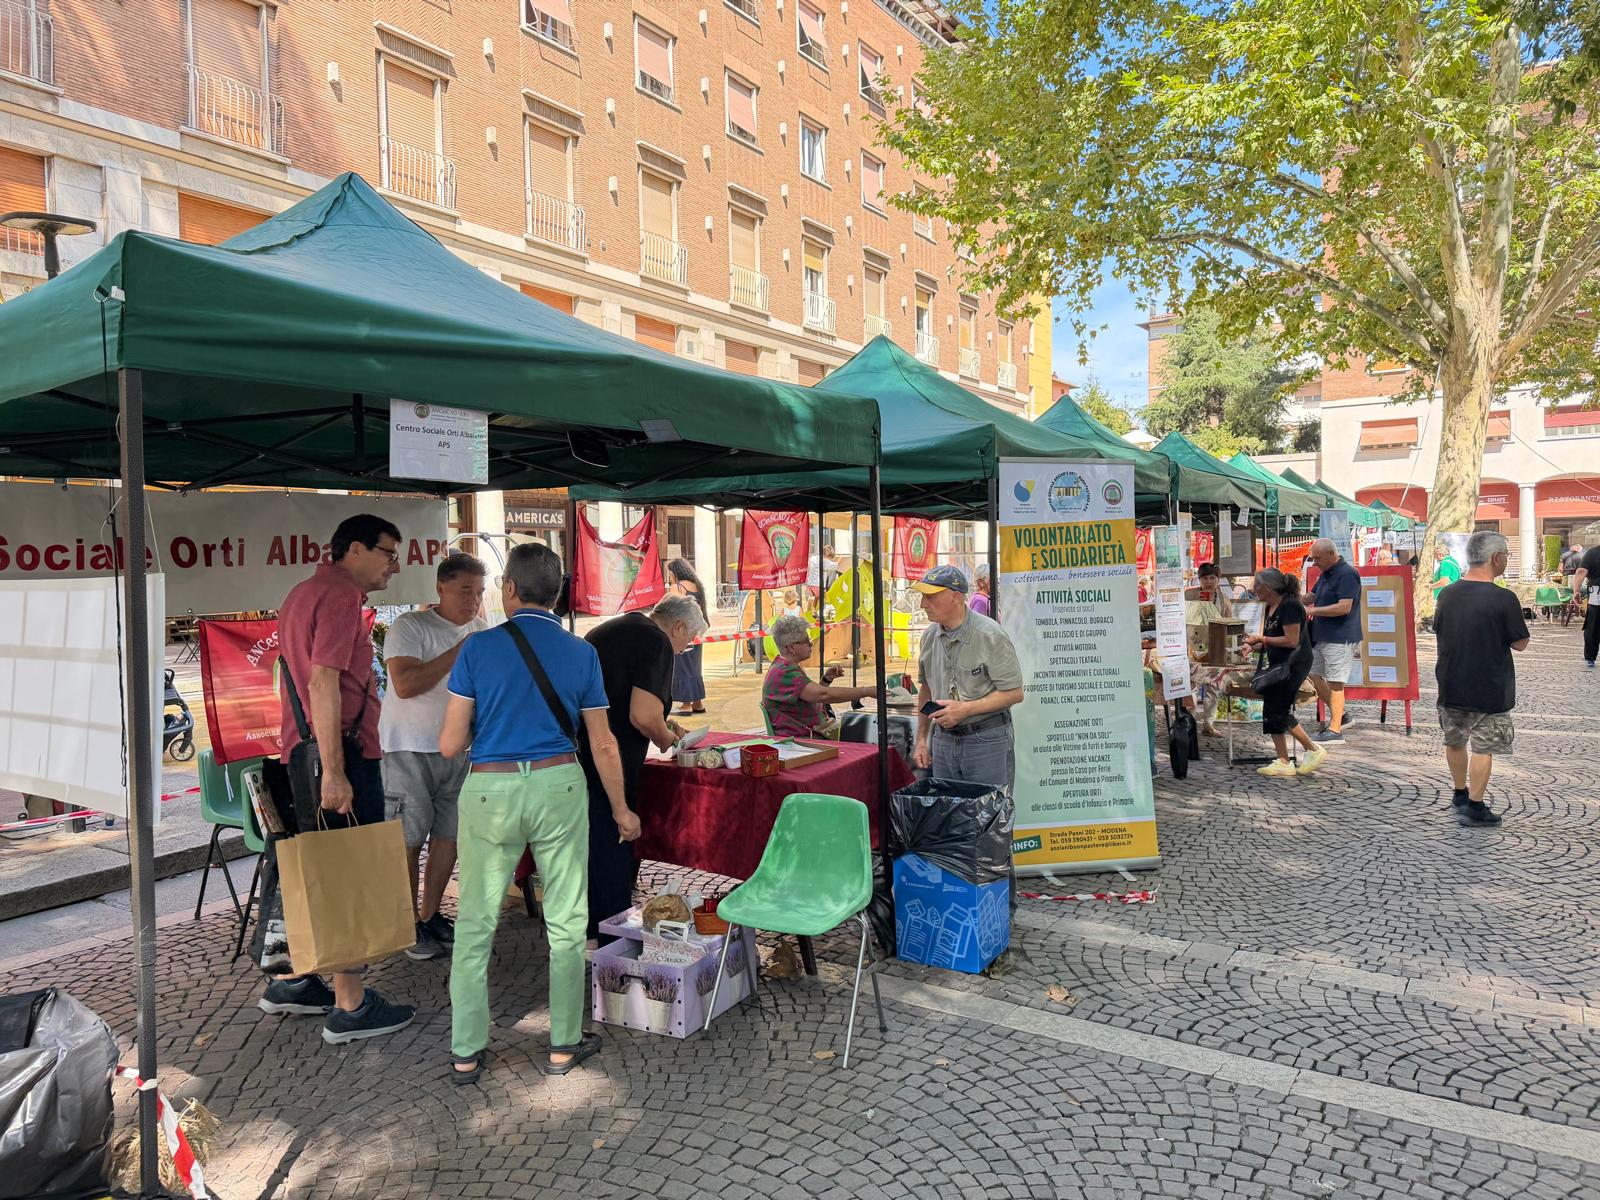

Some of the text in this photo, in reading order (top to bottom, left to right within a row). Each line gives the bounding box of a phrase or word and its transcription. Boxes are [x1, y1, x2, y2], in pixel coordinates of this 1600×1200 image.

[396, 424, 420, 432] Centro
[422, 426, 446, 435] Sociale
[506, 512, 564, 524] AMERICA'S
[1014, 523, 1112, 548] VOLONTARIATO
[170, 536, 245, 568] Orti
[266, 535, 334, 566] Alba
[1032, 540, 1126, 570] E SOLIDARIETÀ
[1014, 566, 1132, 584] coltiviamo... benessere sociale
[1036, 588, 1111, 604] ATTIVITÀ SOCIALI
[1060, 617, 1088, 625] PINNACOLO,
[1090, 616, 1114, 624] BURRACO
[1043, 630, 1058, 638] BALLO
[1086, 629, 1106, 637] GRUPPO
[246, 631, 279, 668] ANCeS
[1054, 642, 1096, 651] ATTIVITÀ MOTORIA
[1050, 656, 1102, 665] SPETTACOLI TEATRALI
[1034, 670, 1056, 679] INCONTRI
[1057, 669, 1088, 678] INFORMATIVI
[1093, 668, 1120, 676] CULTURALI
[1024, 684, 1048, 693] PROPOSTE
[1056, 682, 1077, 691] TURISMO
[1078, 681, 1098, 690] SOCIALE
[1104, 680, 1131, 689] CULTURALE
[1061, 695, 1075, 704] CENE,
[1076, 694, 1097, 703] GNOCCO
[1054, 718, 1103, 728] ASSEGNAZIONE ORTI
[246, 729, 281, 740] Associaz
[1046, 734, 1074, 742] SPORTELLO
[1053, 743, 1062, 751] alle
[1063, 743, 1081, 751] Vittime
[1105, 741, 1127, 750] borseggi
[1050, 755, 1111, 765] PRENOTAZIONE VACANZE
[1051, 767, 1068, 776] presso
[1088, 766, 1097, 774] per
[1098, 765, 1111, 773] Ferie
[1101, 774, 1124, 782] Pinarella
[1063, 788, 1101, 798] APERTURA ORTI
[1031, 803, 1041, 812] alle
[1042, 803, 1057, 811] classi
[1058, 802, 1063, 810] di
[1064, 800, 1080, 809] scuola
[1082, 799, 1107, 808] d'Infanzia
[1113, 797, 1134, 806] Primarie
[1014, 840, 1038, 851] INFO:
